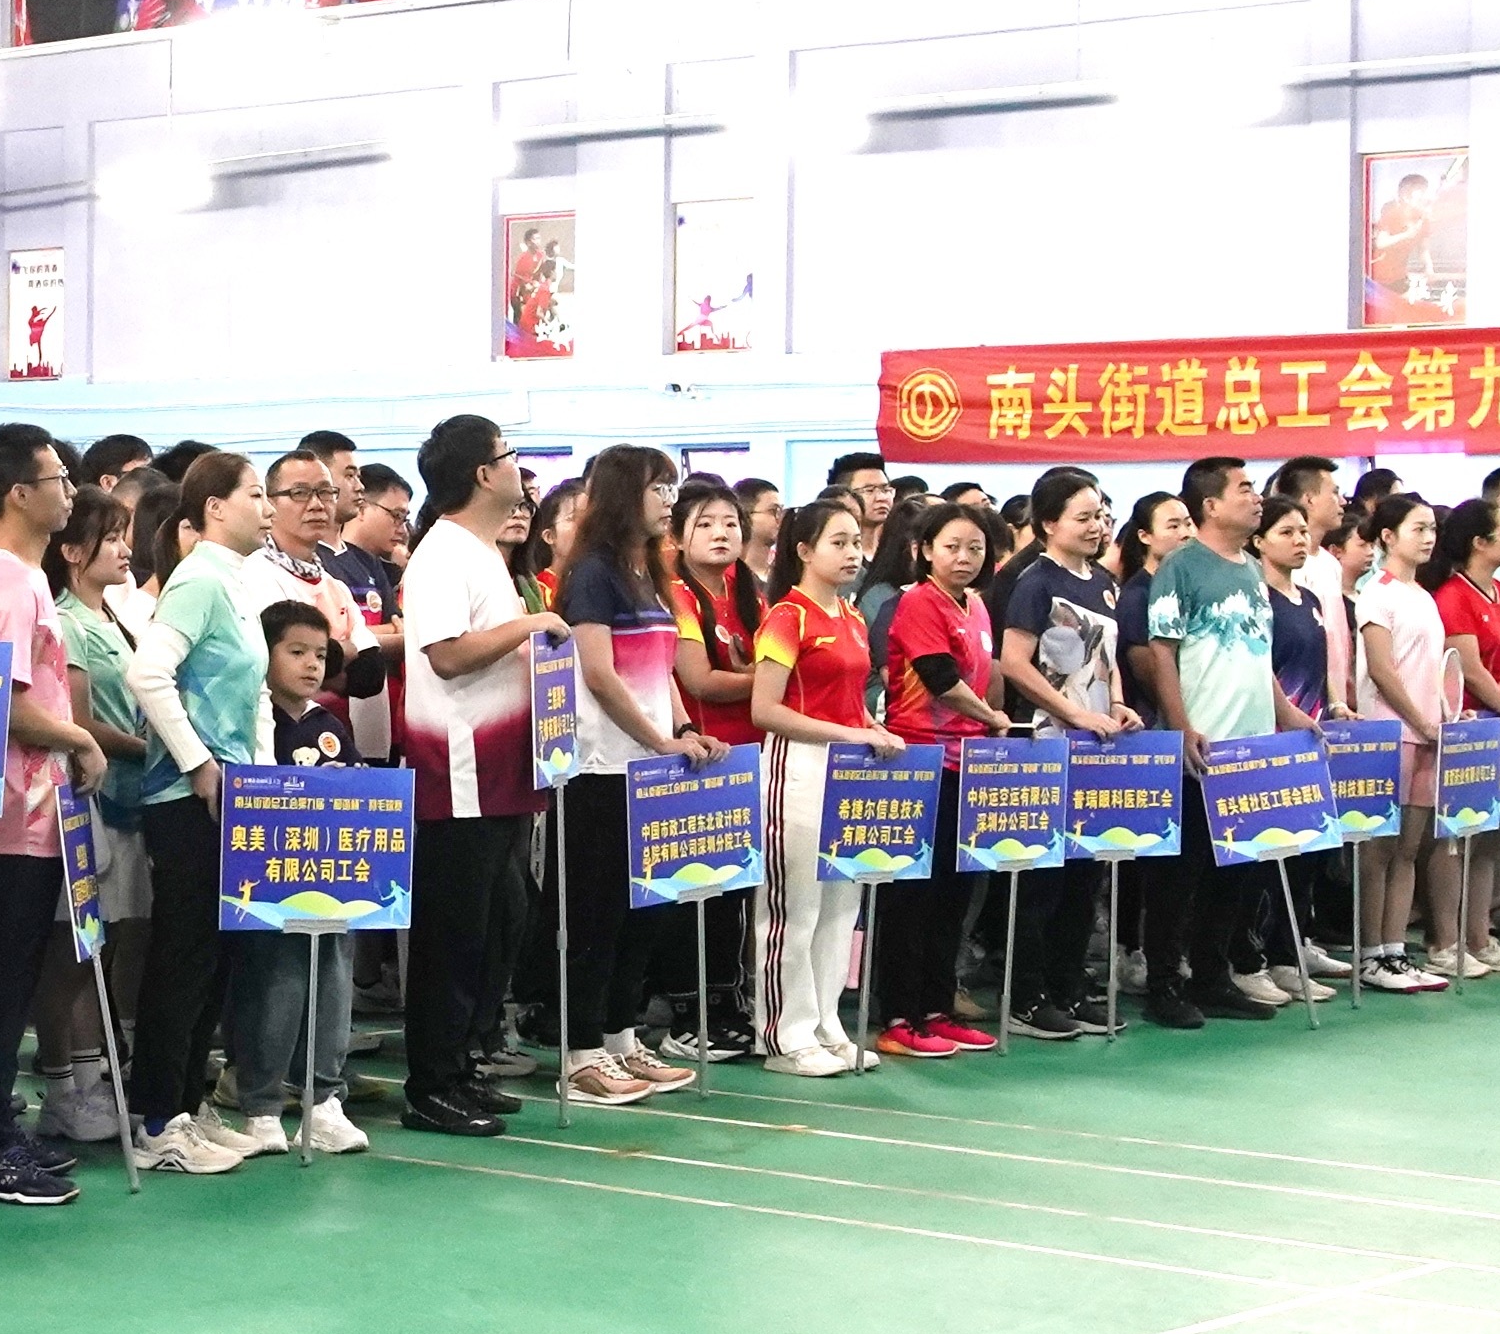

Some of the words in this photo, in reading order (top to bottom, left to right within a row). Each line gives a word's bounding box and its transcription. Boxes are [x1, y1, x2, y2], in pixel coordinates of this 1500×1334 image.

[967, 786, 1061, 807] 中外运空运有限公司
[1073, 788, 1173, 810] 普瑞眼科医院工会
[975, 810, 1050, 833] 深圳分公司工会
[842, 824, 916, 847] 有限公司工会
[265, 857, 371, 884] 有限公司工会
